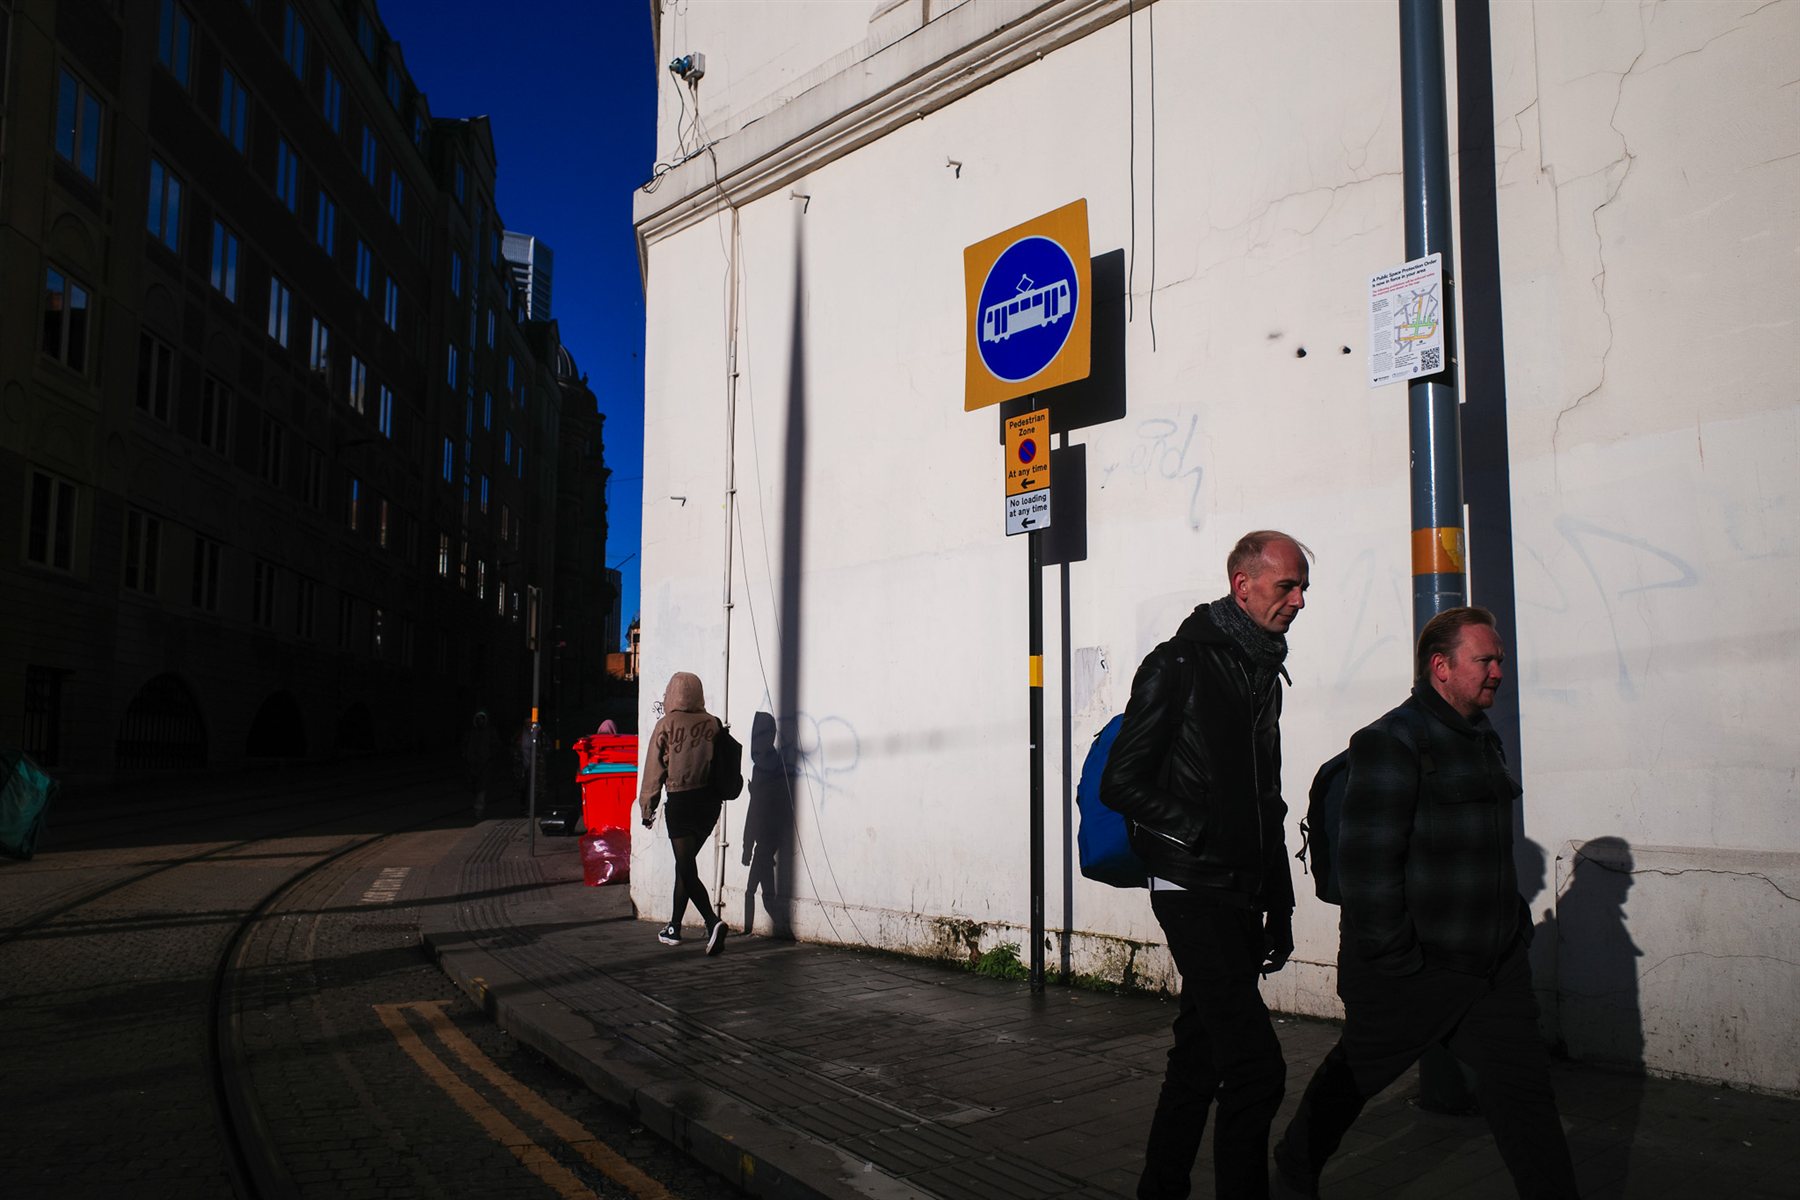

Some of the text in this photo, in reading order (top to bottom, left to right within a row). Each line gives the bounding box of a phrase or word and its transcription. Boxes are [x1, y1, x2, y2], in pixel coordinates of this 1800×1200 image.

[1402, 264, 1423, 273] Protection
[1009, 414, 1045, 429] Pedestrian
[1019, 427, 1035, 436] Zone
[1008, 464, 1047, 479] At any time
[1010, 494, 1047, 507] No loading
[1018, 508, 1030, 516] any
[1032, 504, 1047, 513] time
